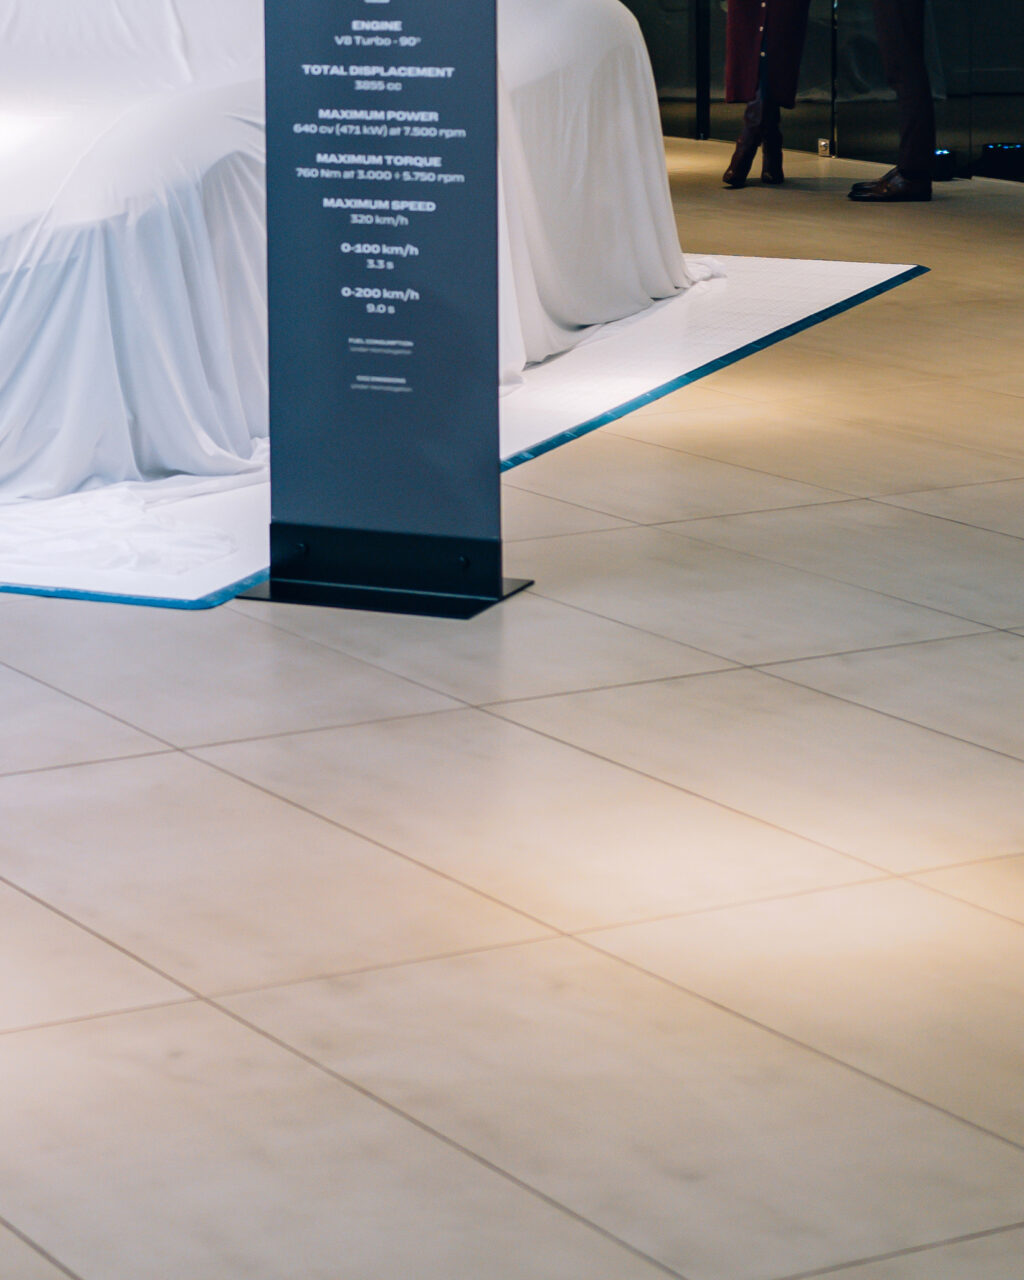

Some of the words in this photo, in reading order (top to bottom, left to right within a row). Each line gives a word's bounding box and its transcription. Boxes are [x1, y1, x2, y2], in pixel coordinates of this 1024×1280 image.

[351, 20, 402, 31] ENGINE
[334, 35, 353, 46] V8
[354, 35, 392, 46] Turbo
[301, 64, 348, 76] TOTAL
[349, 65, 455, 78] DISPLACEMENT
[318, 109, 385, 120] MAXIMUM
[386, 110, 439, 122] POWER
[293, 123, 318, 134] 640
[318, 125, 335, 134] cv
[335, 123, 361, 136] (471
[362, 124, 388, 137] kW)
[389, 127, 402, 136] at
[403, 126, 438, 137] 7.500
[438, 129, 466, 139] rpm
[316, 153, 383, 165] MAXIMUM
[384, 155, 442, 168] TORQUE
[296, 167, 319, 178] 760
[320, 169, 342, 178] Nm
[342, 170, 355, 179] at
[357, 169, 392, 181] 3.000
[402, 171, 436, 182] 5.750
[436, 174, 465, 184] rpm
[323, 198, 390, 210] MAXIMUM
[391, 200, 436, 212] SPEED
[350, 214, 374, 224] 320
[374, 214, 409, 227] km/h
[340, 242, 381, 254] 0-100
[382, 244, 419, 257] km/h
[367, 259, 385, 269] 3.3
[386, 261, 394, 270] s
[341, 287, 382, 298] 0-200
[382, 288, 420, 302] km/h
[366, 303, 387, 314] 9.0
[387, 305, 395, 314] s
